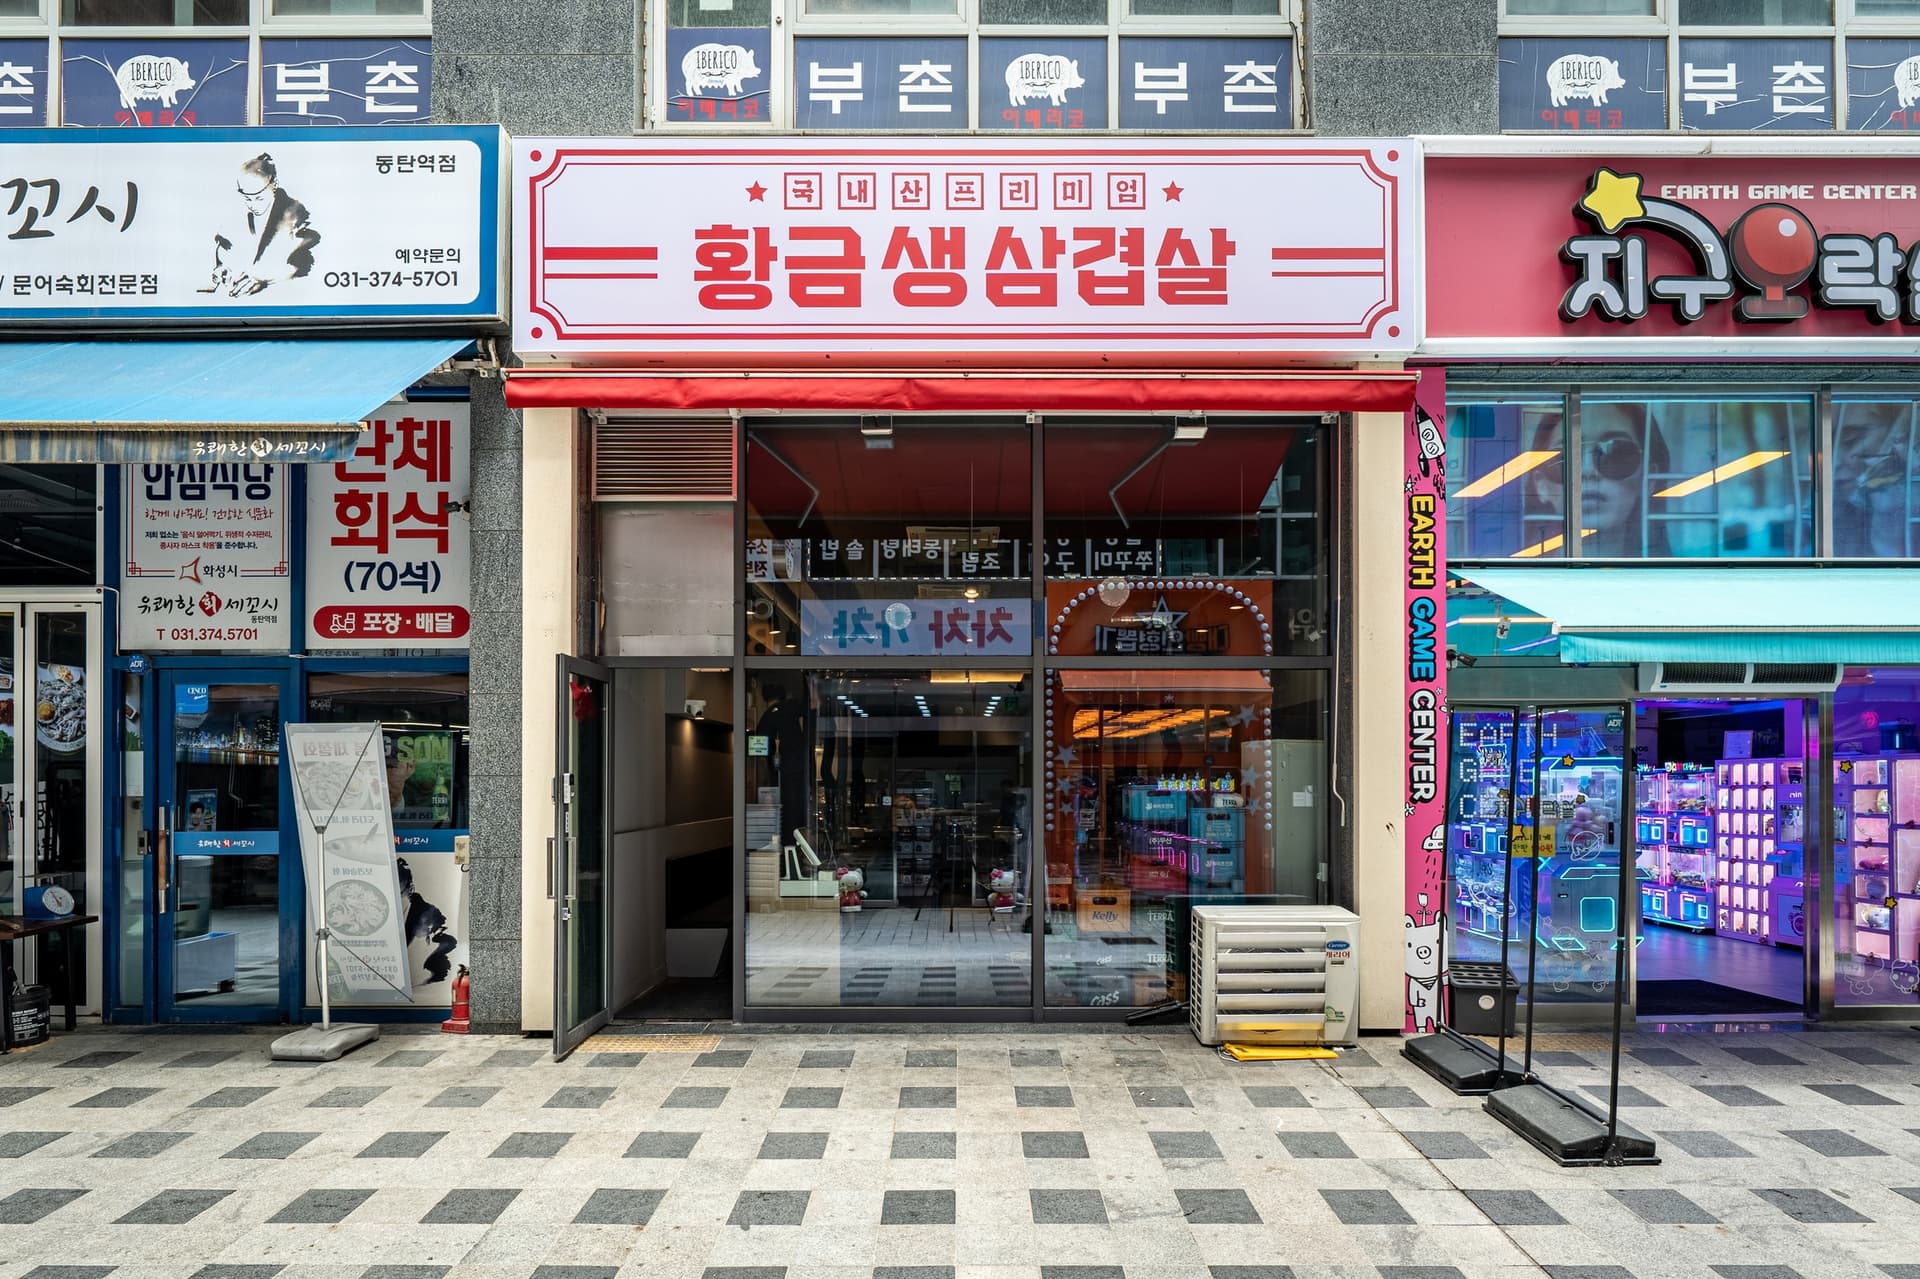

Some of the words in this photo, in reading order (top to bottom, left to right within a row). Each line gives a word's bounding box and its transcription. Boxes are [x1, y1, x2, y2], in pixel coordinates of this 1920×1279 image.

[696, 50, 737, 69] IBERICO
[131, 62, 172, 81] IBERICO
[1020, 60, 1061, 80] IBERICO
[1560, 61, 1602, 80] IBERICO
[375, 153, 457, 174] 동탄역점
[1661, 184, 1739, 200] EARTH
[1748, 184, 1814, 200] GAME
[1823, 184, 1917, 200] CENTER
[394, 247, 461, 264] 예약문의
[694, 224, 1236, 310] 황금생삼겹살
[13, 272, 159, 296] 문어숙회전문점
[324, 271, 458, 289] 031-374-5701
[275, 440, 326, 455] 세꼬시
[143, 463, 274, 501] 안심식당
[331, 489, 450, 554] 회식
[1410, 495, 1436, 589] EARTH
[202, 565, 239, 579] 화성시
[344, 560, 442, 594] (70석)
[137, 594, 195, 616] 유쾌한
[199, 592, 222, 616] 회
[225, 597, 278, 614] 세꼬시
[251, 615, 278, 624] 동탄역점
[156, 628, 166, 641] T
[171, 628, 258, 641] 031.374.5701
[1410, 596, 1436, 682] GAME
[129, 660, 144, 668] ADT
[1607, 719, 1622, 727] ADT
[397, 735, 449, 763] SON
[1410, 689, 1436, 803] CENTER
[1092, 911, 1119, 922] Kelly
[1147, 909, 1175, 922] TERRA
[1146, 953, 1174, 964] TERRA
